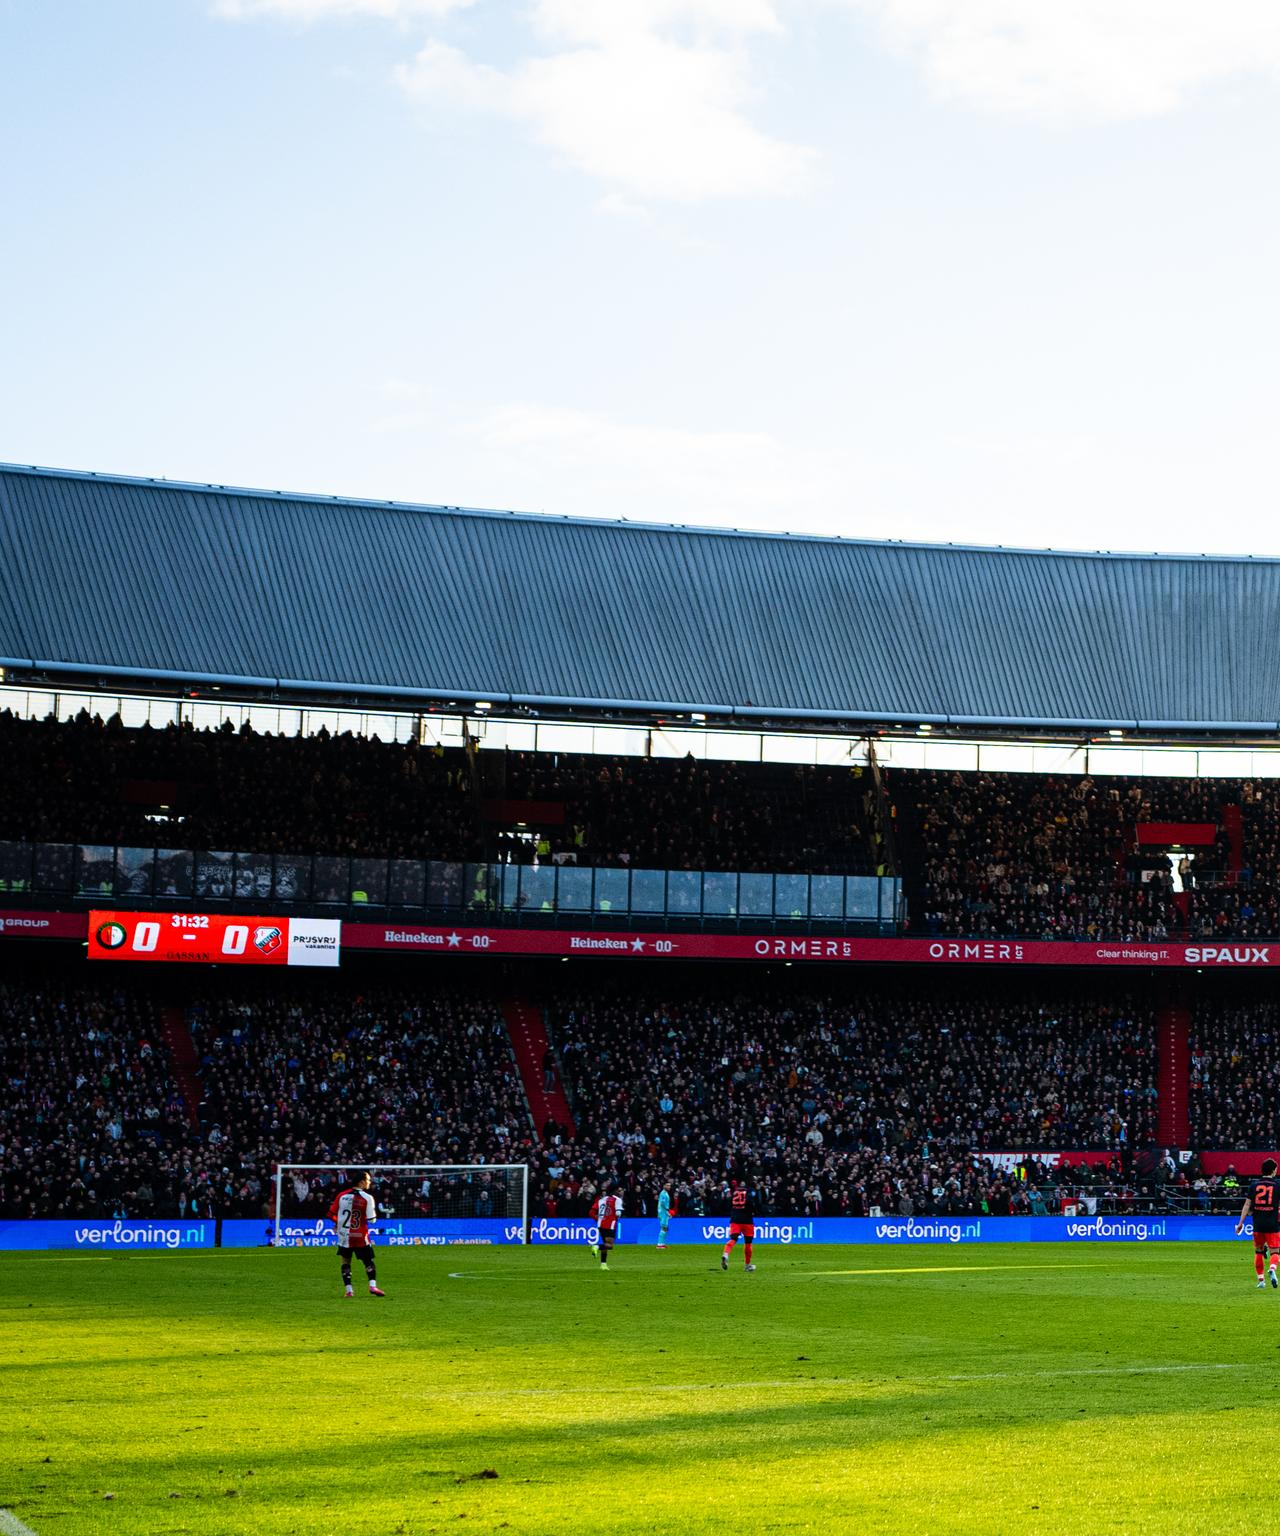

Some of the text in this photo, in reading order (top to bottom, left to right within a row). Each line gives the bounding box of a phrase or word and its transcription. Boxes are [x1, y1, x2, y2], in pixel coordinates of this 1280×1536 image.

[5, 918, 49, 928] GROUP
[171, 915, 209, 928] 31:32
[132, 921, 160, 952] 0
[221, 925, 249, 955] 0
[384, 931, 444, 943] Heineken
[570, 937, 628, 949] Heineken
[166, 951, 210, 961] GASSAN
[755, 940, 838, 956] ORMER
[929, 943, 1011, 959] ORMER
[1096, 949, 1121, 958] Clear
[1122, 949, 1157, 960] thinking
[1184, 948, 1270, 962] SPAUX
[1255, 1185, 1275, 1205] 21
[342, 1208, 362, 1231] 23
[75, 1220, 204, 1248] verloning.nl
[703, 1221, 813, 1244] verning.nl
[875, 1218, 981, 1242] verloning.nl
[1066, 1216, 1166, 1240] verloning.nl
[448, 1237, 492, 1246] vakanties
